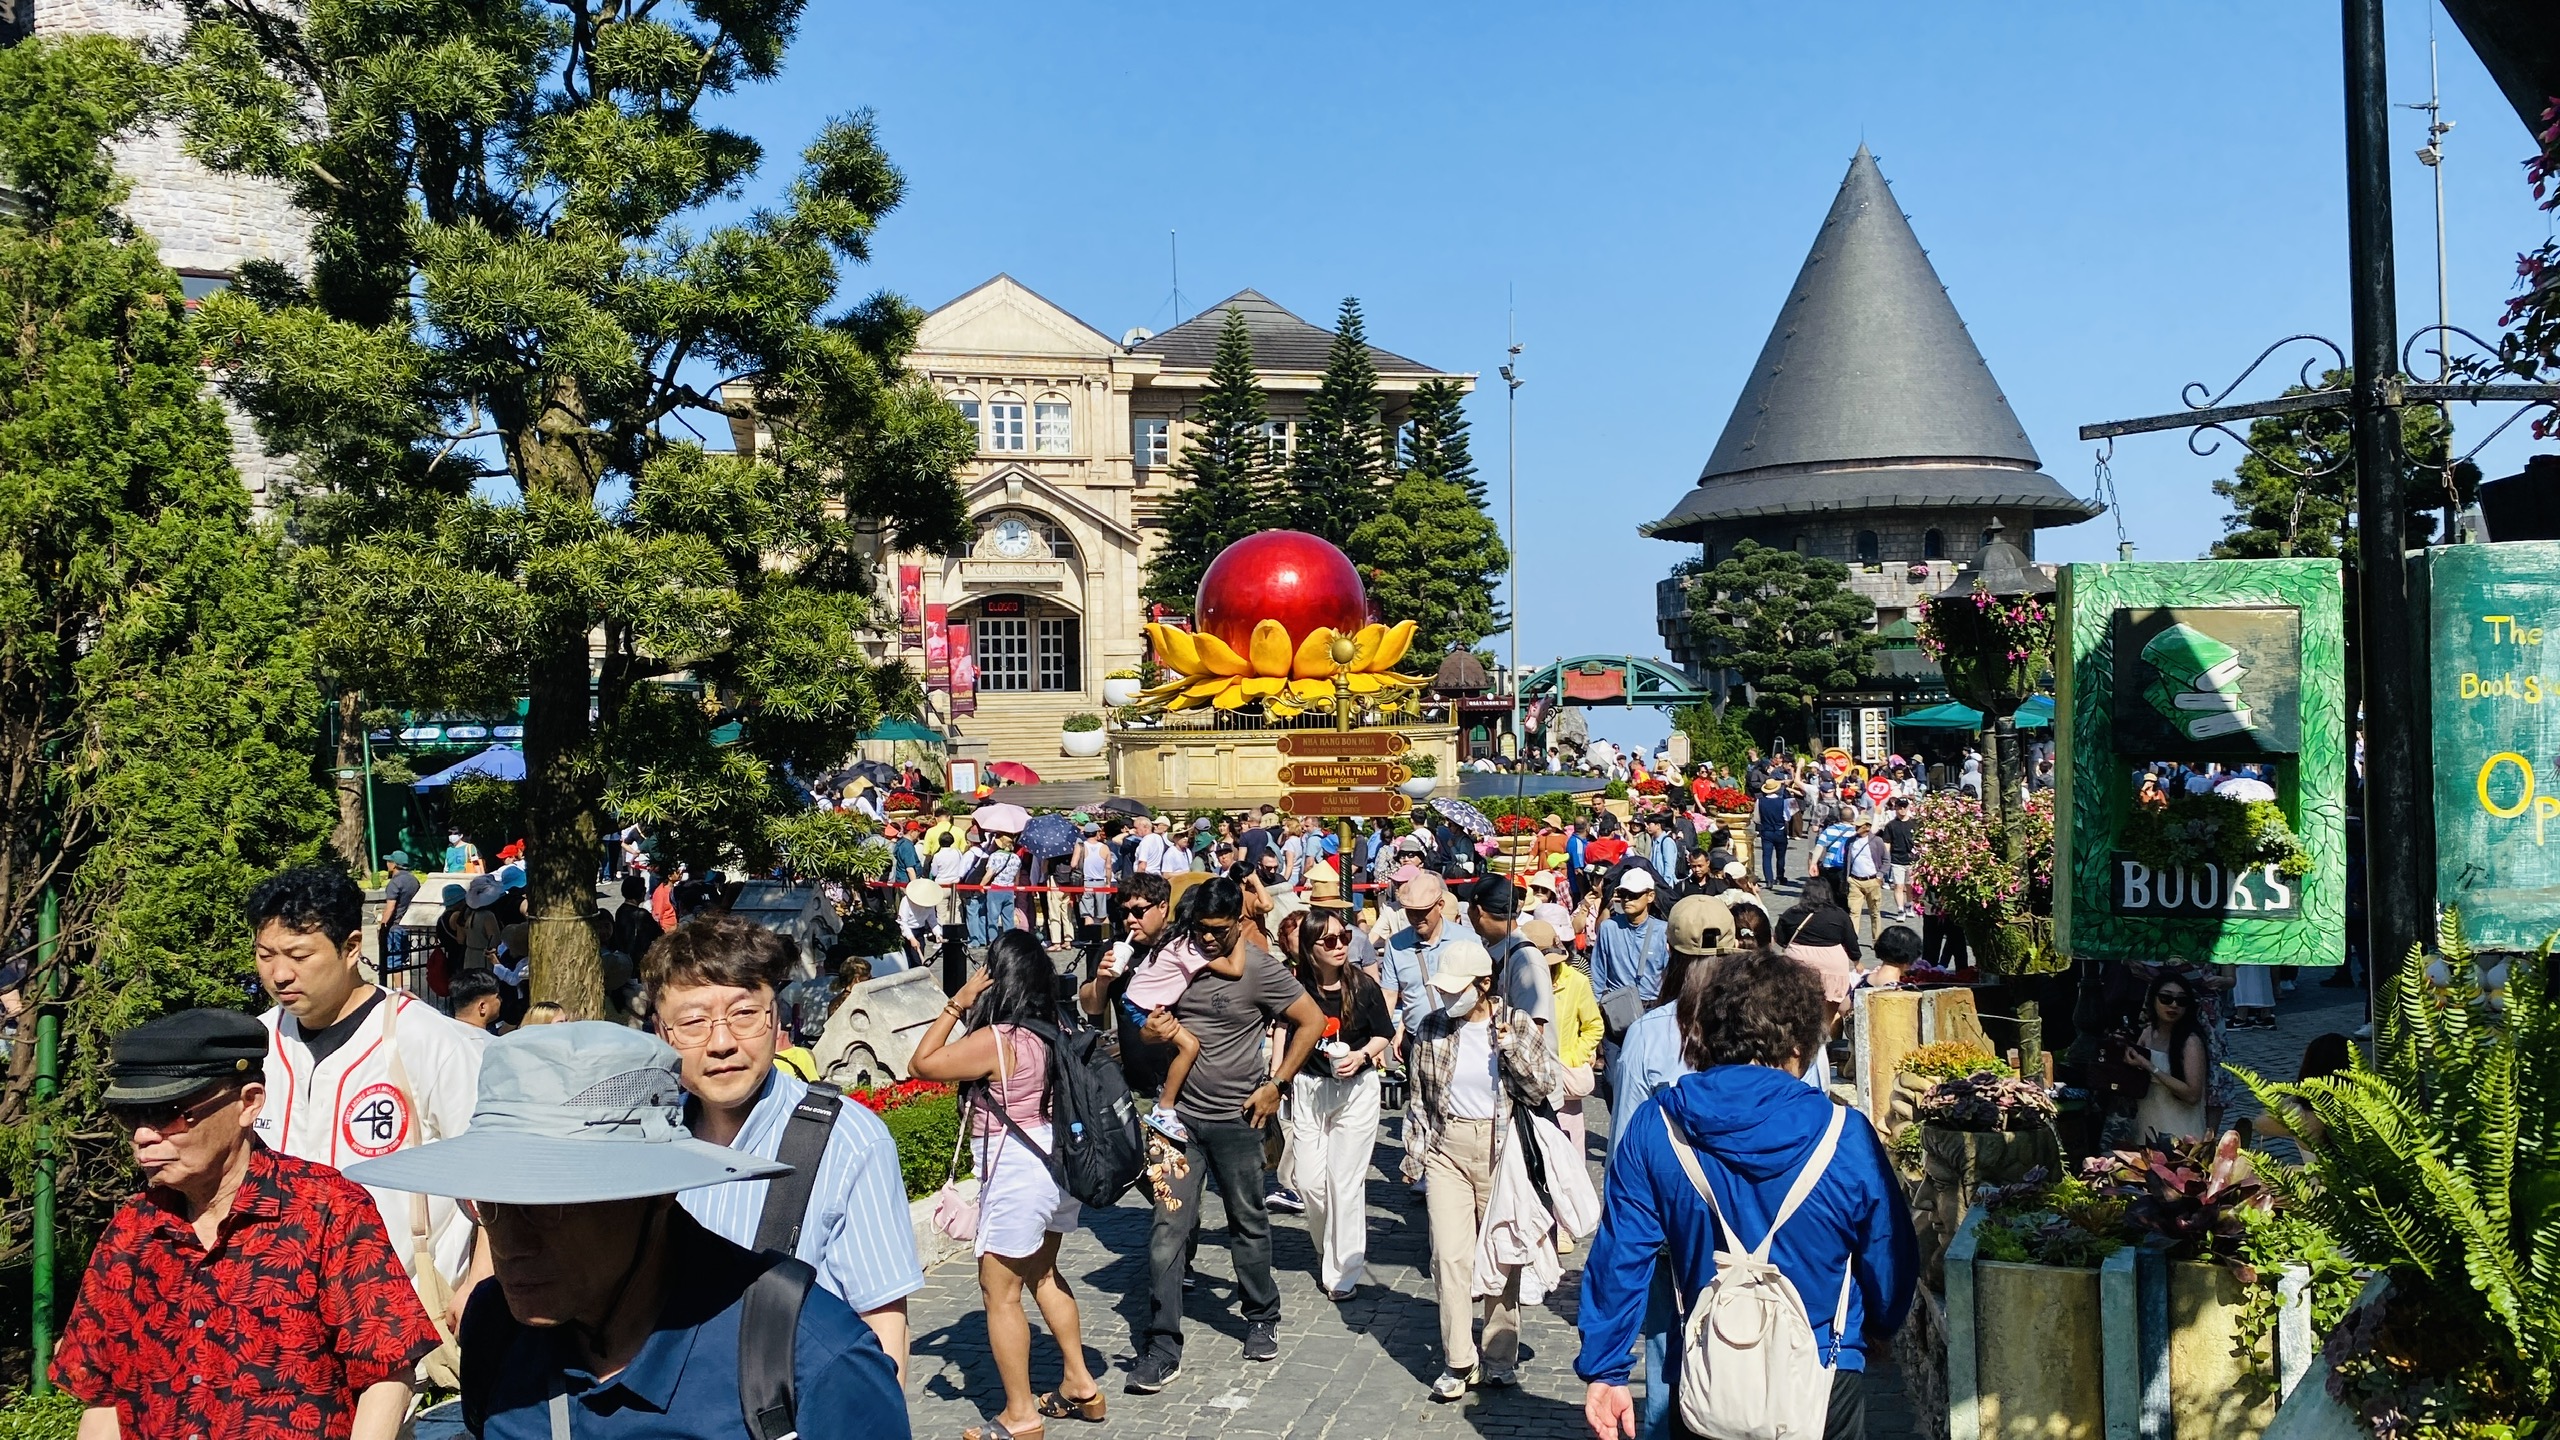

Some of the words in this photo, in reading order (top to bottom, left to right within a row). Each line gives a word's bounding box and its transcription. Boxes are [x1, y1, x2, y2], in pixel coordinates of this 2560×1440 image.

[975, 566, 1005, 575] GARE
[1013, 566, 1051, 575] MORIN
[988, 602, 1018, 612] CLOSED
[2482, 615, 2543, 645] The
[2122, 861, 2290, 911] BOOKS
